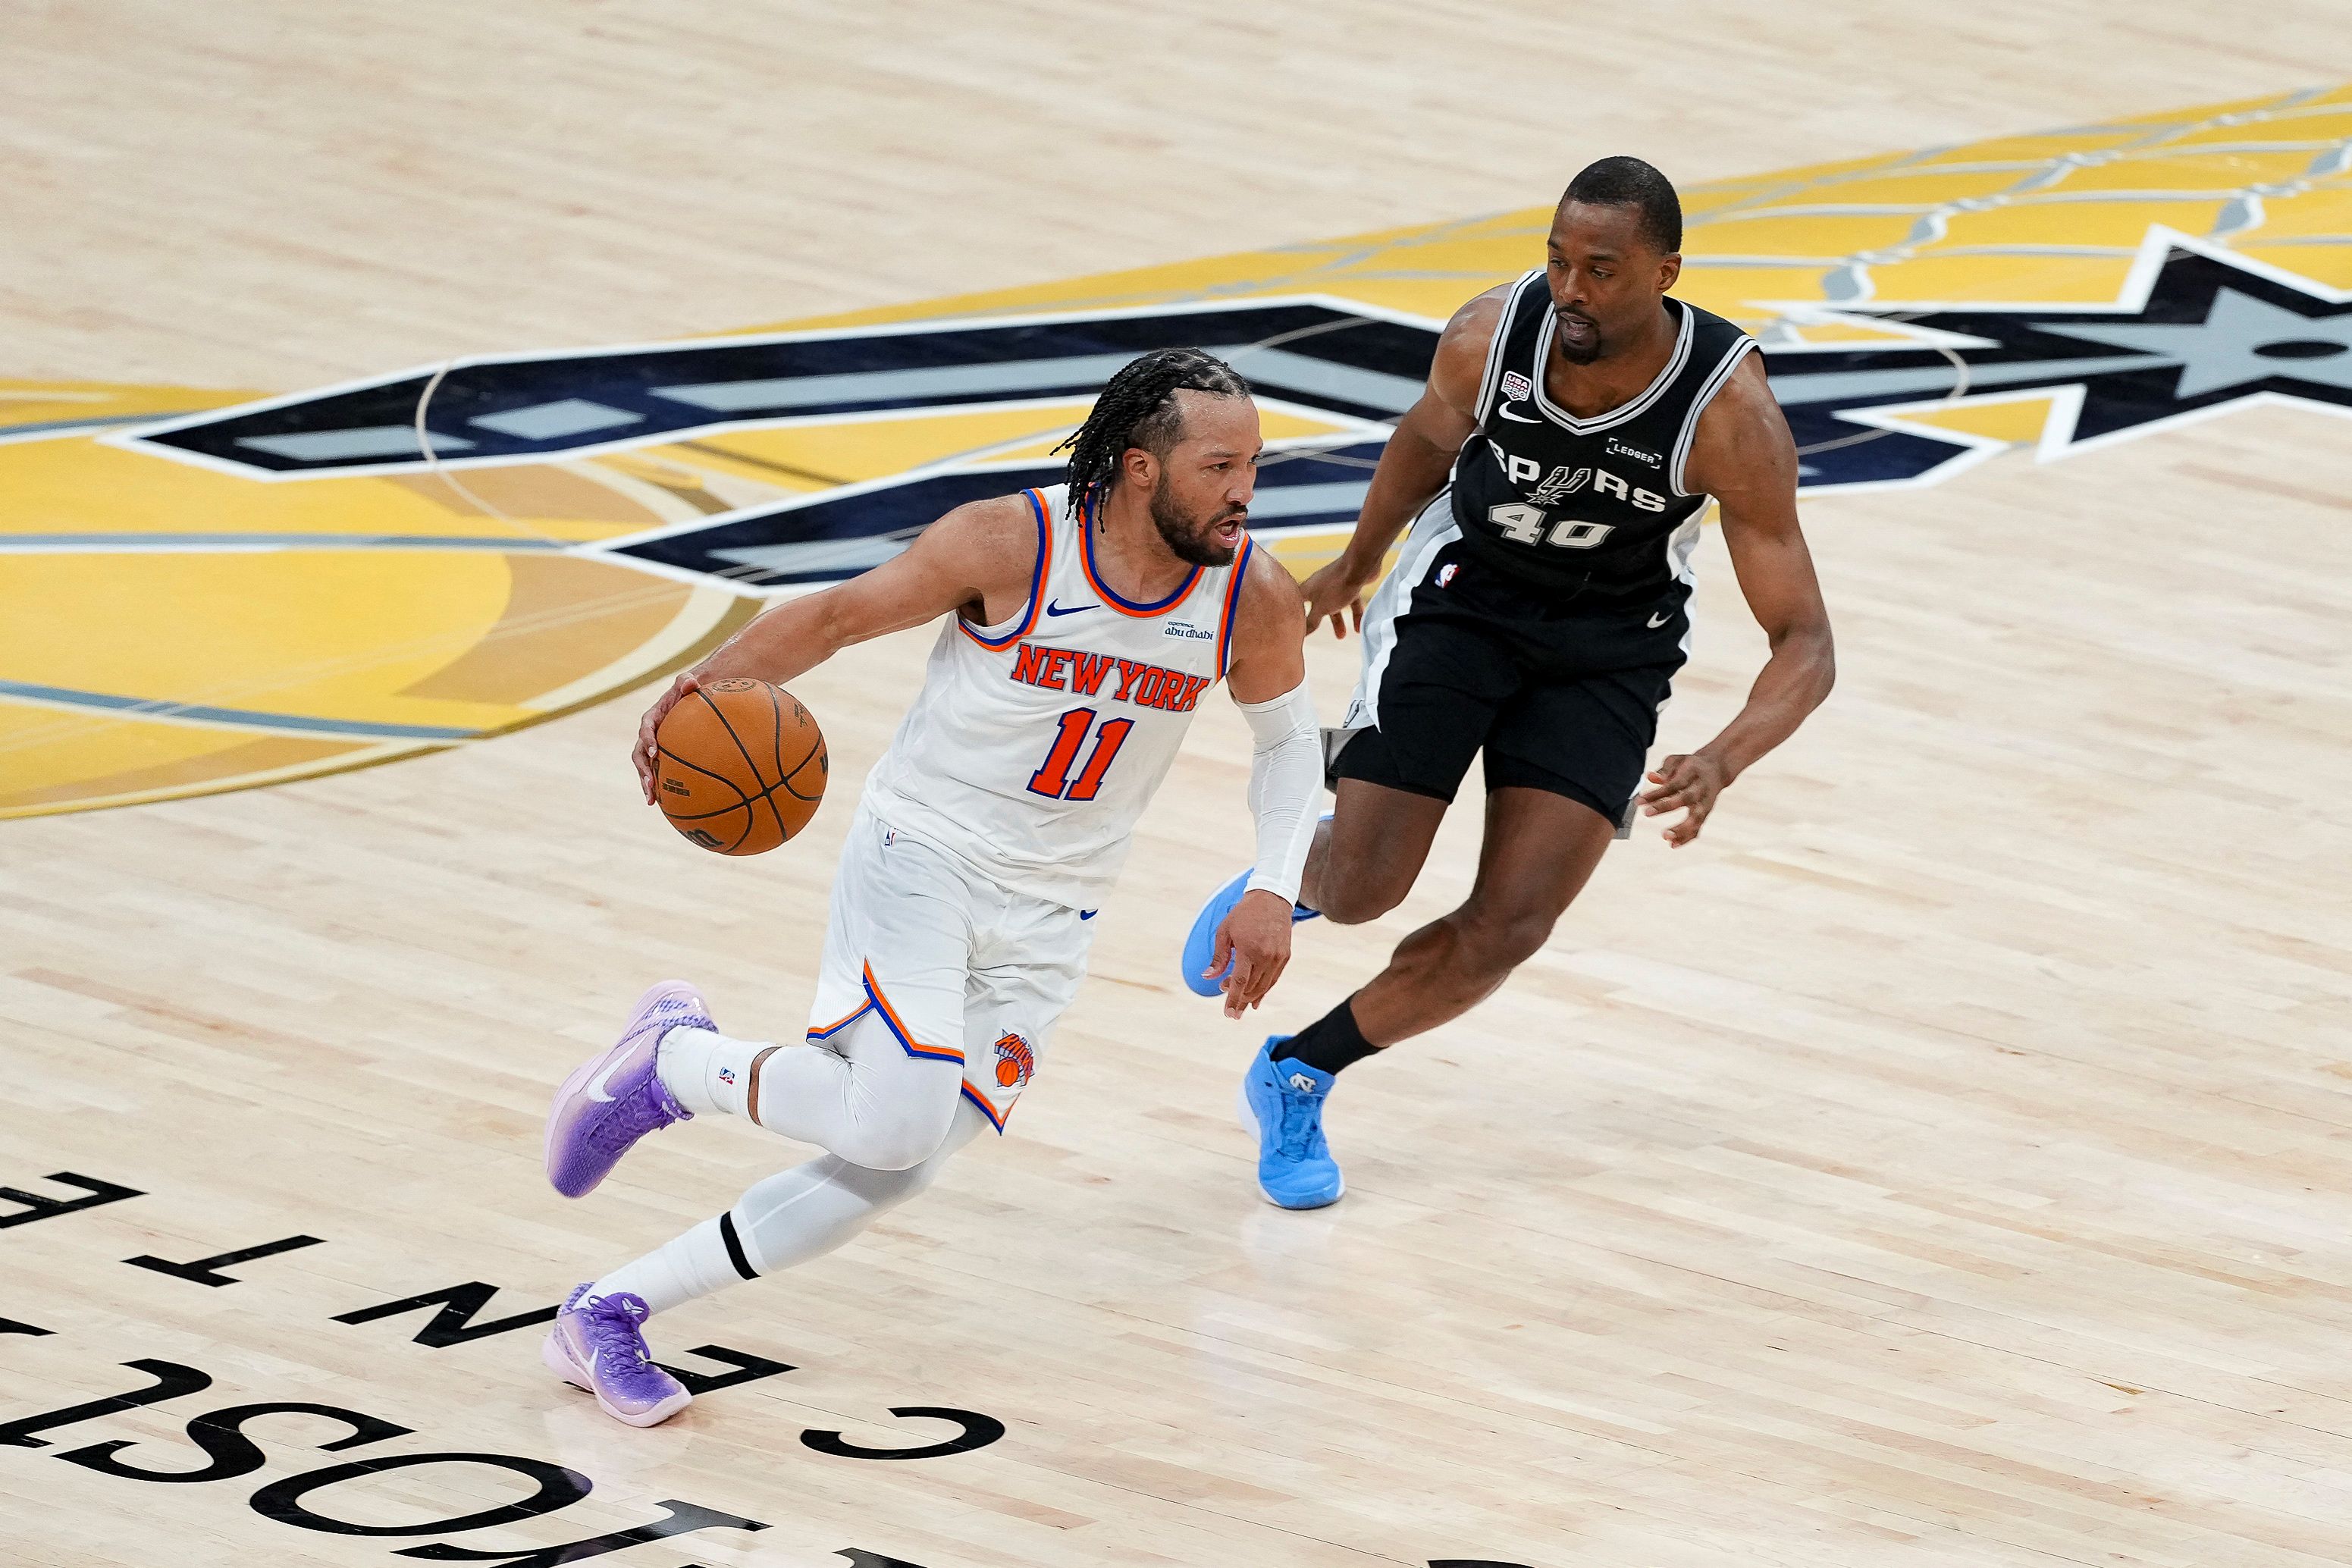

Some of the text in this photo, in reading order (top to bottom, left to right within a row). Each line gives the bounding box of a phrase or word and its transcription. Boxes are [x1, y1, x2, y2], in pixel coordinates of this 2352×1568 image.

[1508, 375, 1528, 388] USA
[1504, 384, 1526, 399] 250
[1613, 444, 1654, 463] LEDGER
[1488, 502, 1617, 549] 40
[1165, 626, 1215, 640] abu dhabi
[1010, 643, 1212, 713] NEW YORK
[1026, 707, 1136, 801] 11
